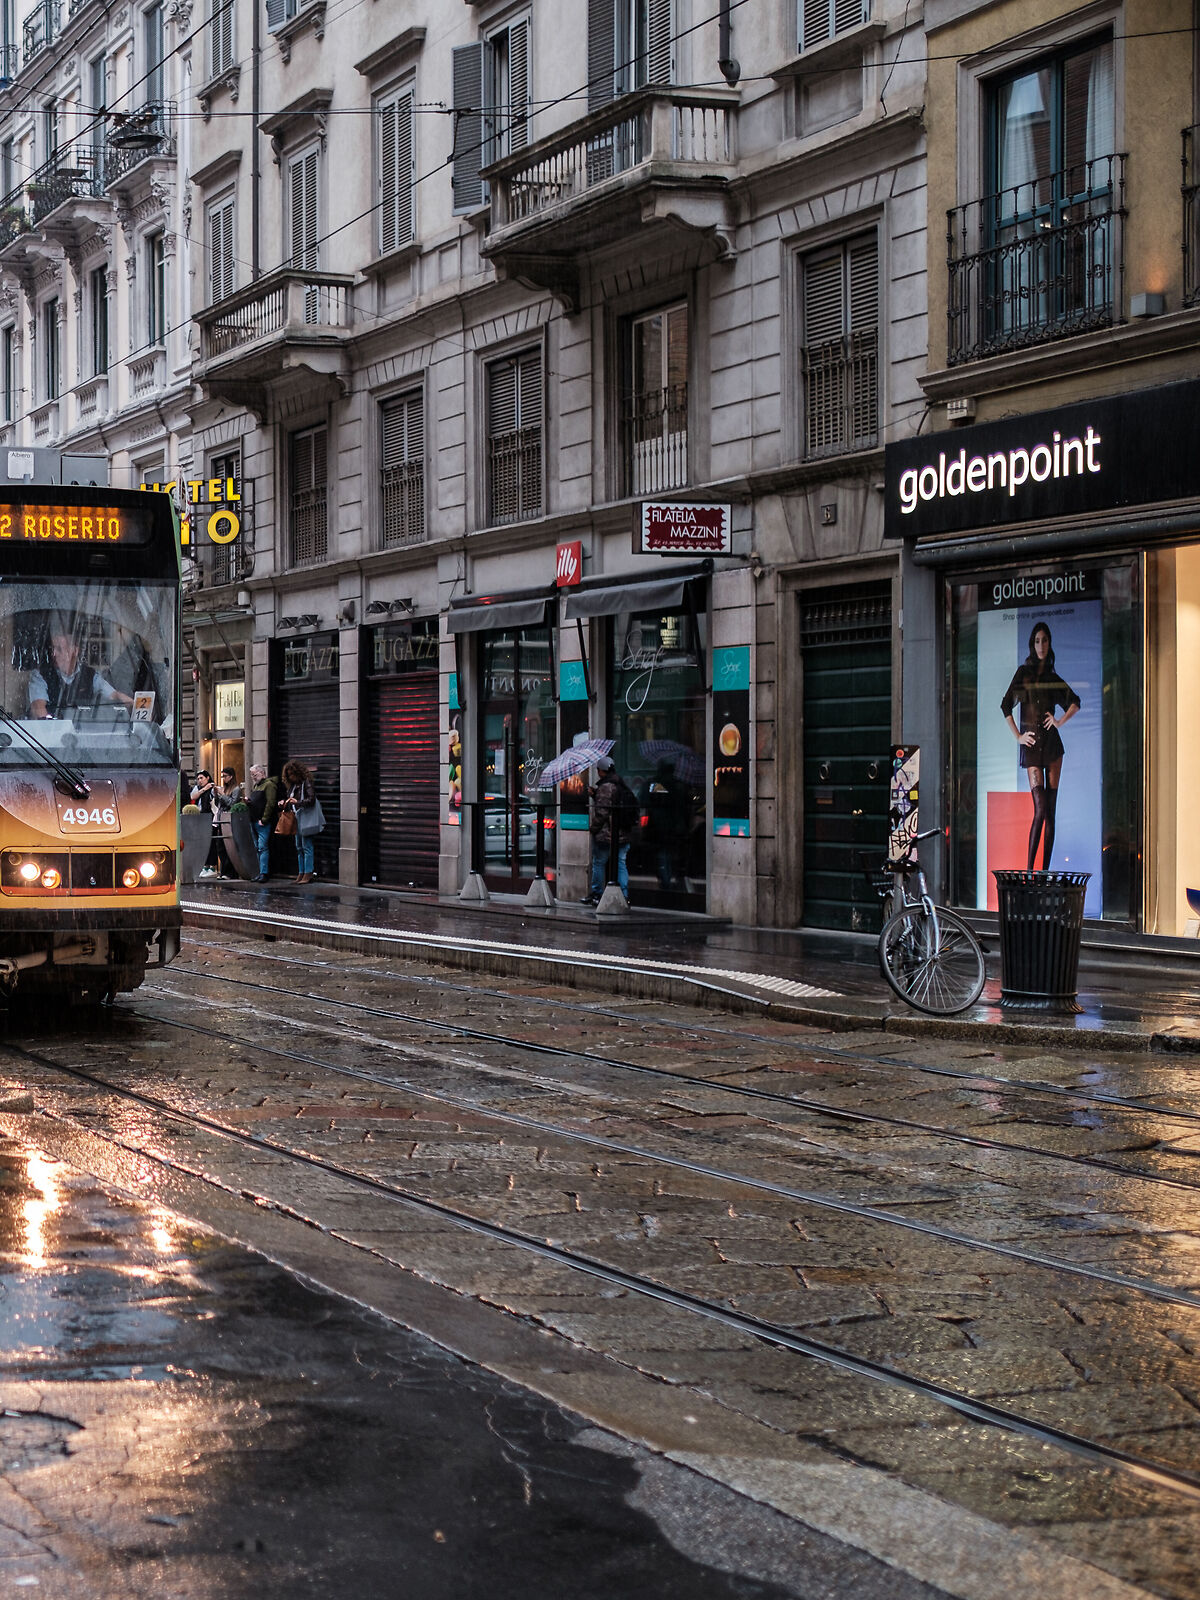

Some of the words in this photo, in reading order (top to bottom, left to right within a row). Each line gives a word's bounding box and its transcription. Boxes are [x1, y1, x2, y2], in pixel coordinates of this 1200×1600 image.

[900, 425, 1101, 514] goldenpoint
[652, 510, 697, 524] FILATELIA
[24, 516, 121, 540] ROSERIO
[670, 525, 719, 539] MAZZINI
[557, 548, 578, 583] illy
[993, 571, 1086, 606] goldenpoint
[140, 697, 148, 709] 2
[135, 710, 149, 721] 12
[63, 808, 116, 825] 4946
